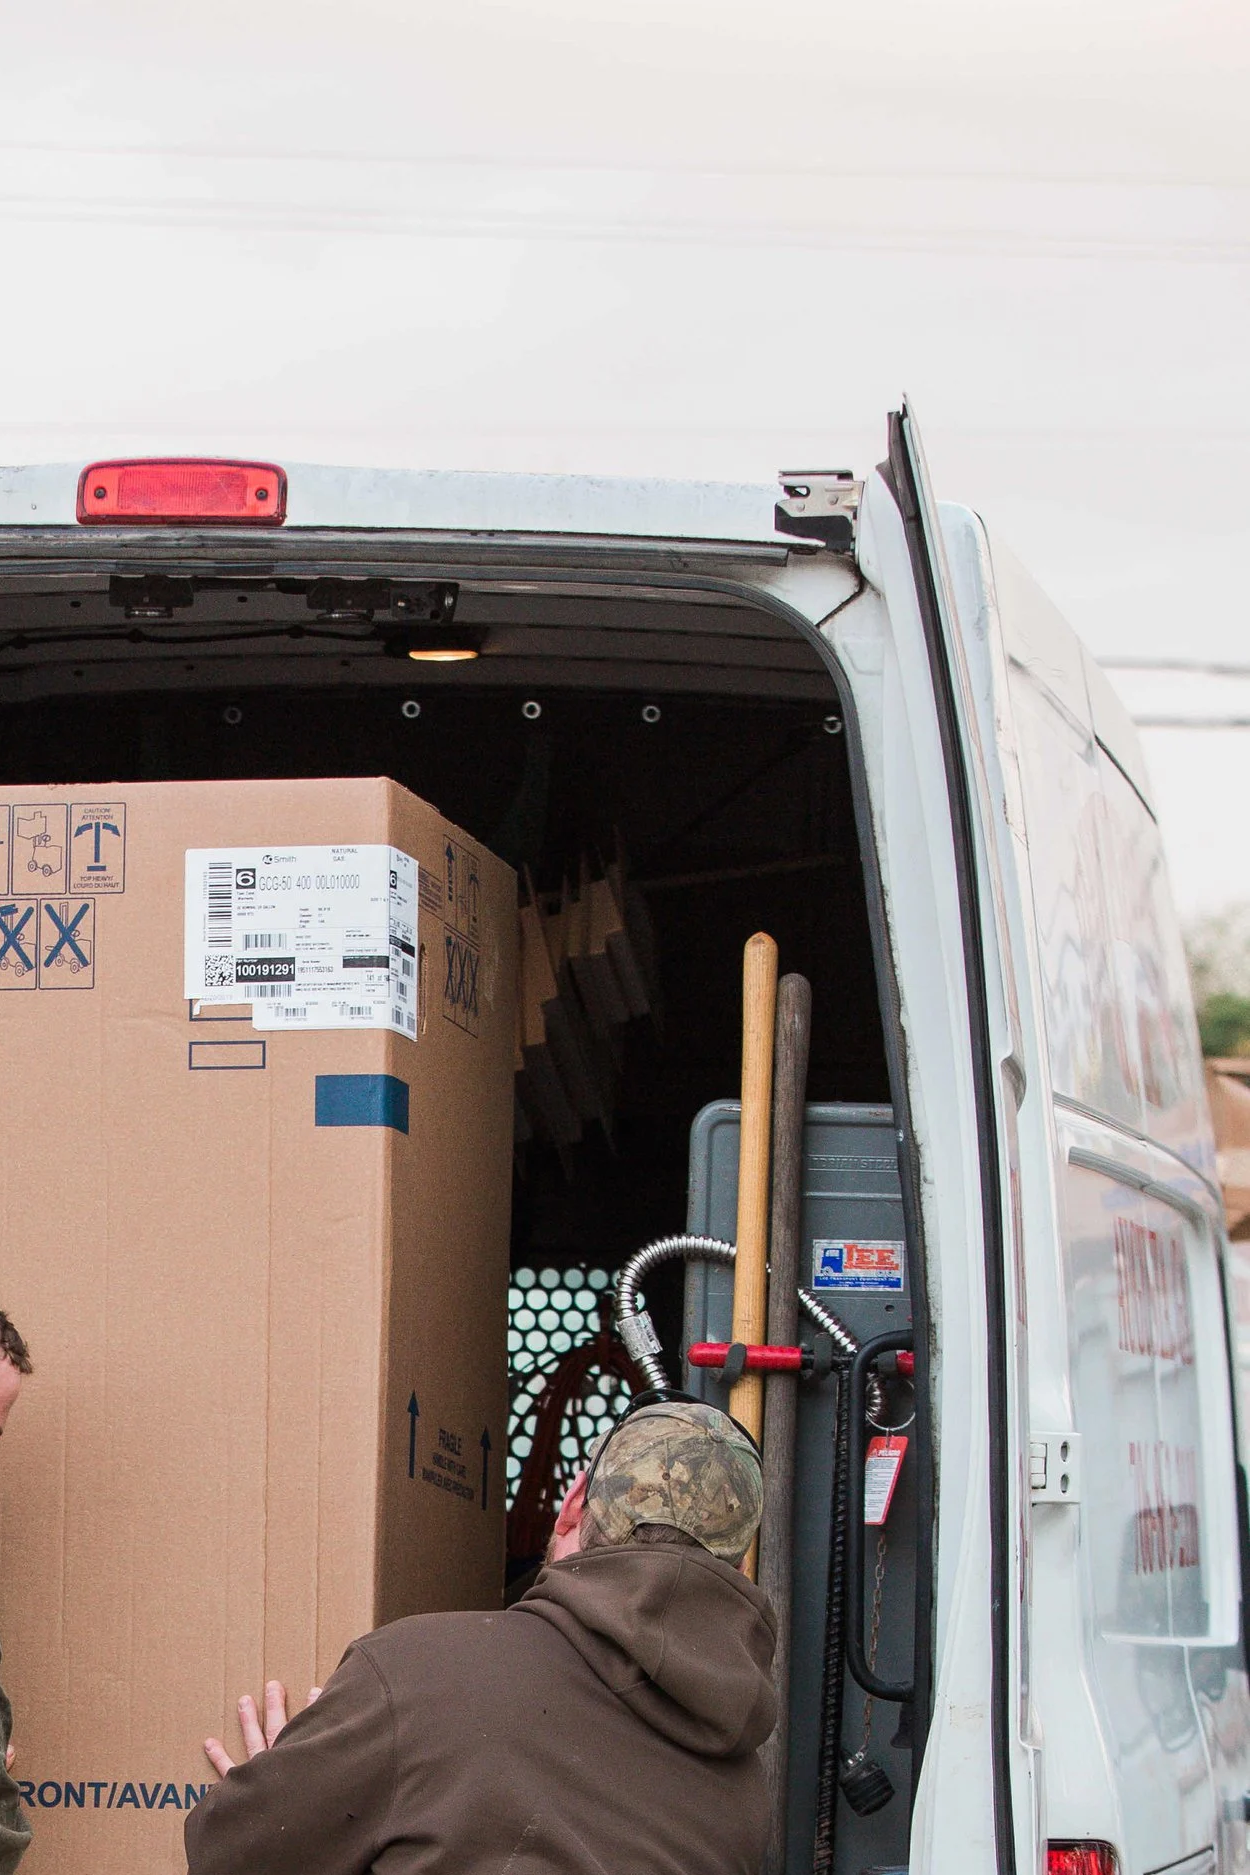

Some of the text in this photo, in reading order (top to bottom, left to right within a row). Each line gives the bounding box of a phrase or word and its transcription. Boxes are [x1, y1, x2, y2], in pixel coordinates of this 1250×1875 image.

[274, 855, 297, 864] Smith
[236, 871, 255, 886] 6
[296, 875, 311, 890] 400
[236, 963, 294, 977] 100191291
[843, 1244, 899, 1270] LEE
[17, 1780, 214, 1810] RONT/AVAN
